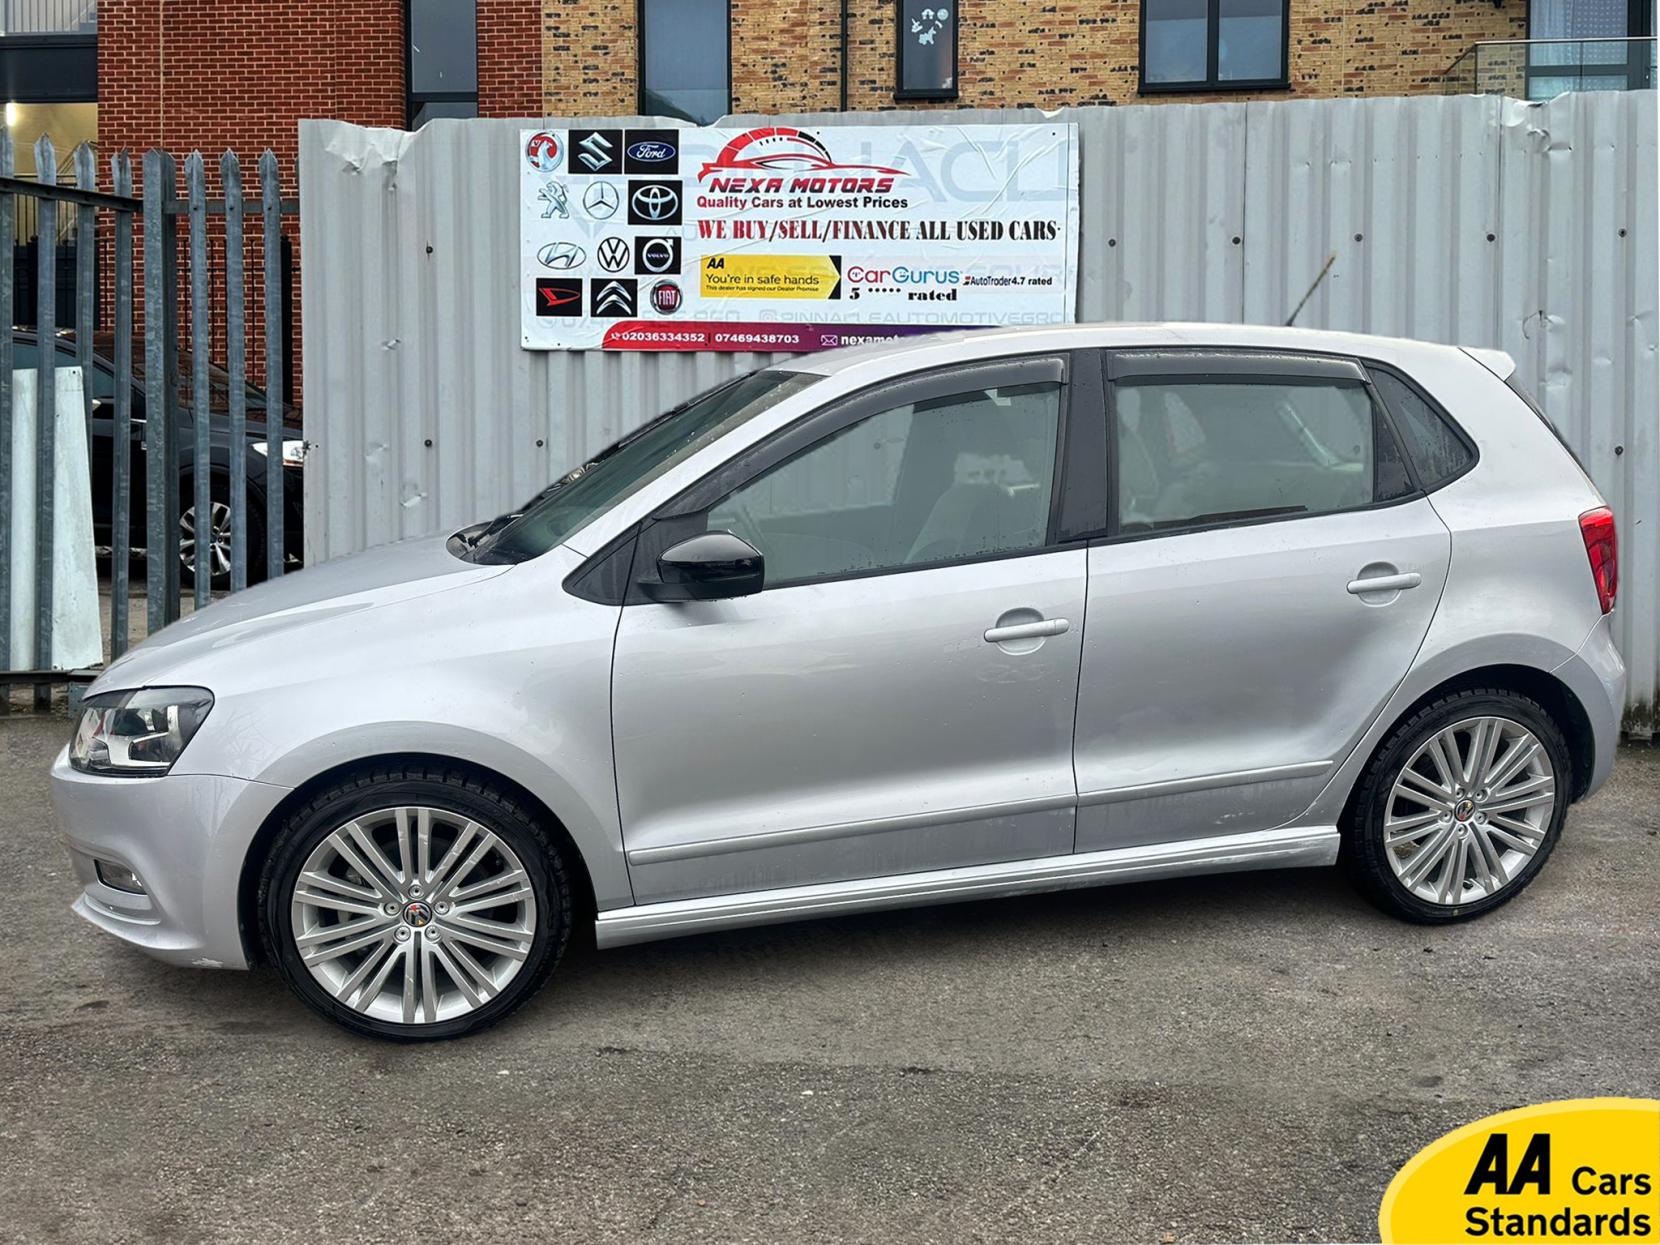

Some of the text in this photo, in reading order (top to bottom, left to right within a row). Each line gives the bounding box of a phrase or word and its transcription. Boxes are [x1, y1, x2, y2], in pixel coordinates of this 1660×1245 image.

[636, 144, 666, 159] Ford
[709, 178, 894, 193] NEXA MOTORS
[697, 196, 908, 210] Quality Cars at Lowest Prices
[697, 220, 727, 239] WE
[916, 221, 950, 240] ALL
[956, 221, 1003, 240] USED
[1008, 221, 1057, 240] CARS
[706, 257, 725, 269] AA
[706, 274, 819, 285] You're in safe hands
[847, 266, 960, 284] CarGurus
[1028, 277, 1052, 285] rated
[658, 290, 675, 305] FIAT
[849, 288, 957, 301] 5 rated
[622, 332, 705, 342] 02036334352
[715, 333, 799, 344] 07469438703
